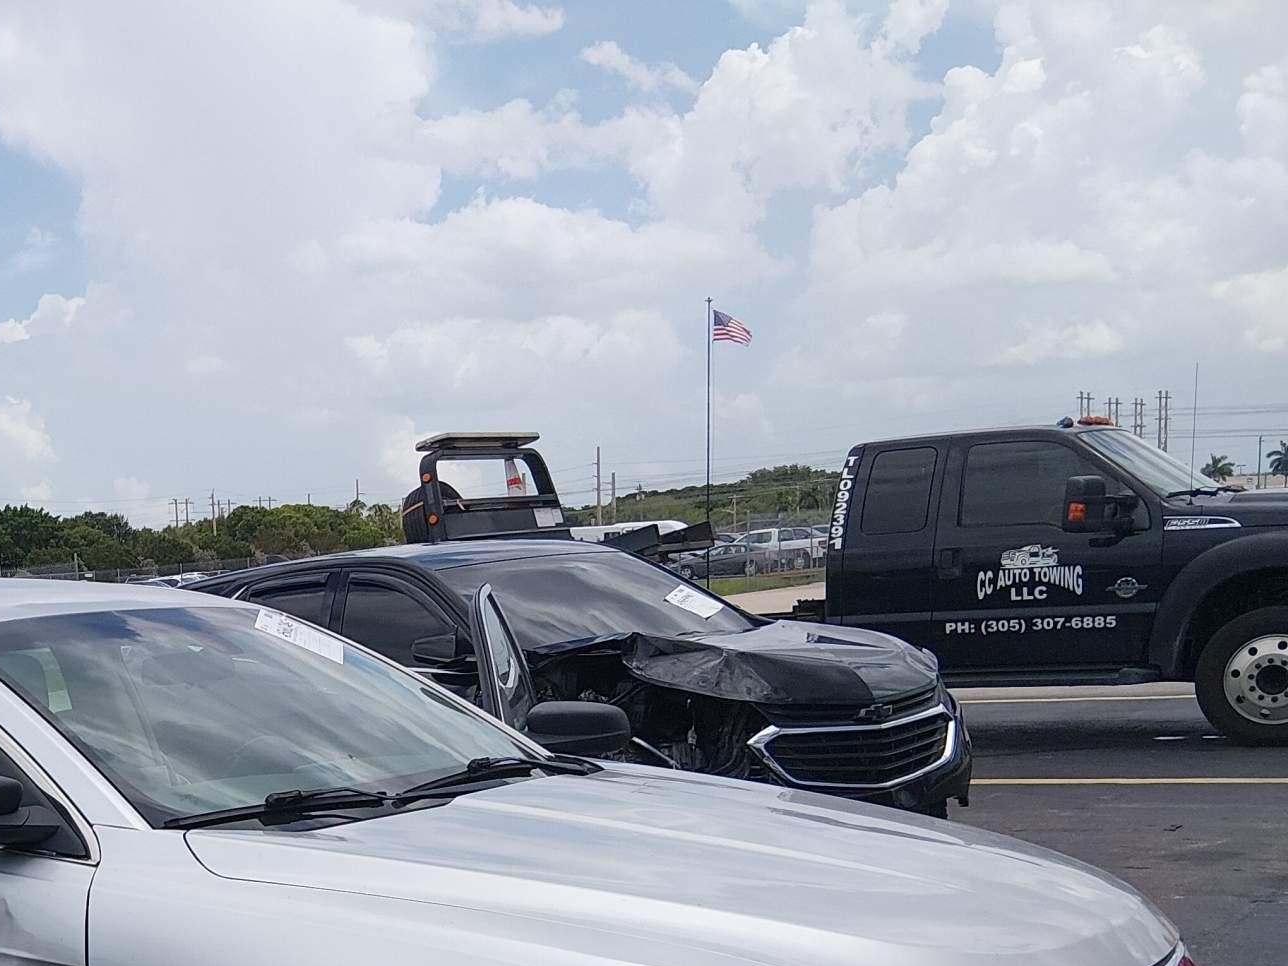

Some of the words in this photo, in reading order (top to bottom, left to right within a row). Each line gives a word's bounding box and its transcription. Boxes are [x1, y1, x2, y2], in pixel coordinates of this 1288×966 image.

[829, 456, 859, 550] TL092391
[976, 570, 994, 600] CC
[996, 568, 1030, 590] AUTO
[1032, 565, 1083, 595] TOWING
[1010, 585, 1048, 601] LLC
[945, 621, 976, 635] PH:
[980, 618, 1027, 636] (305)
[1031, 615, 1118, 631] 307-6885
